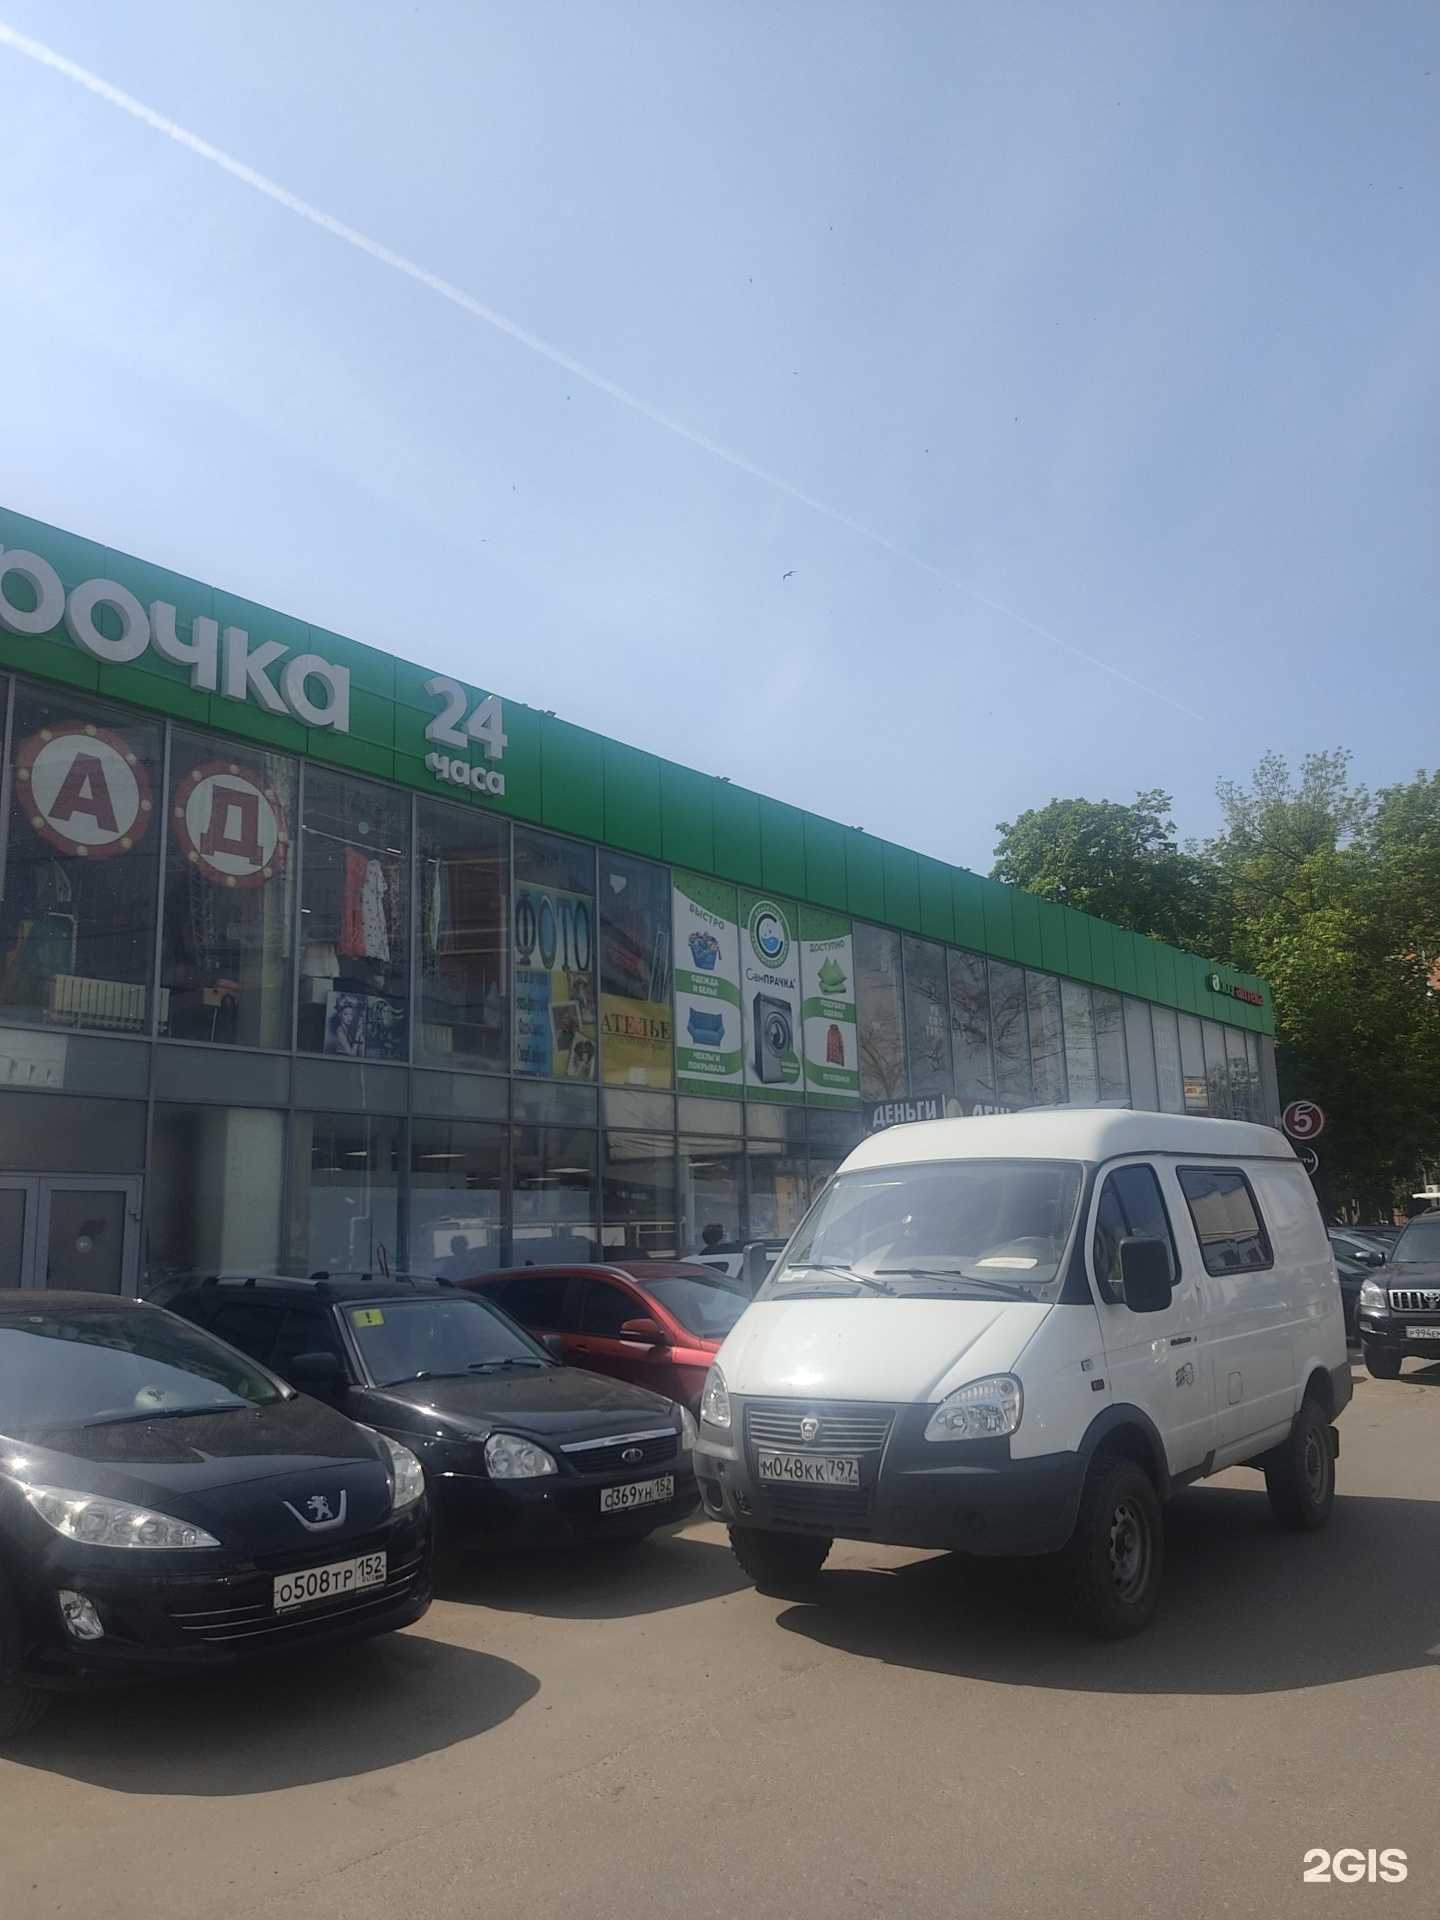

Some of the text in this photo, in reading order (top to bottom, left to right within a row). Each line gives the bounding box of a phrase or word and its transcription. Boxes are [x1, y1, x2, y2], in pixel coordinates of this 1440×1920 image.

[424, 676, 508, 760] 24
[424, 752, 505, 796] часа
[514, 889, 590, 972] ФОТО
[689, 903, 725, 930] БЫСТРО
[601, 1011, 672, 1040] АТЕЛЬЕ
[873, 1101, 937, 1128] ДЕНЬГИ
